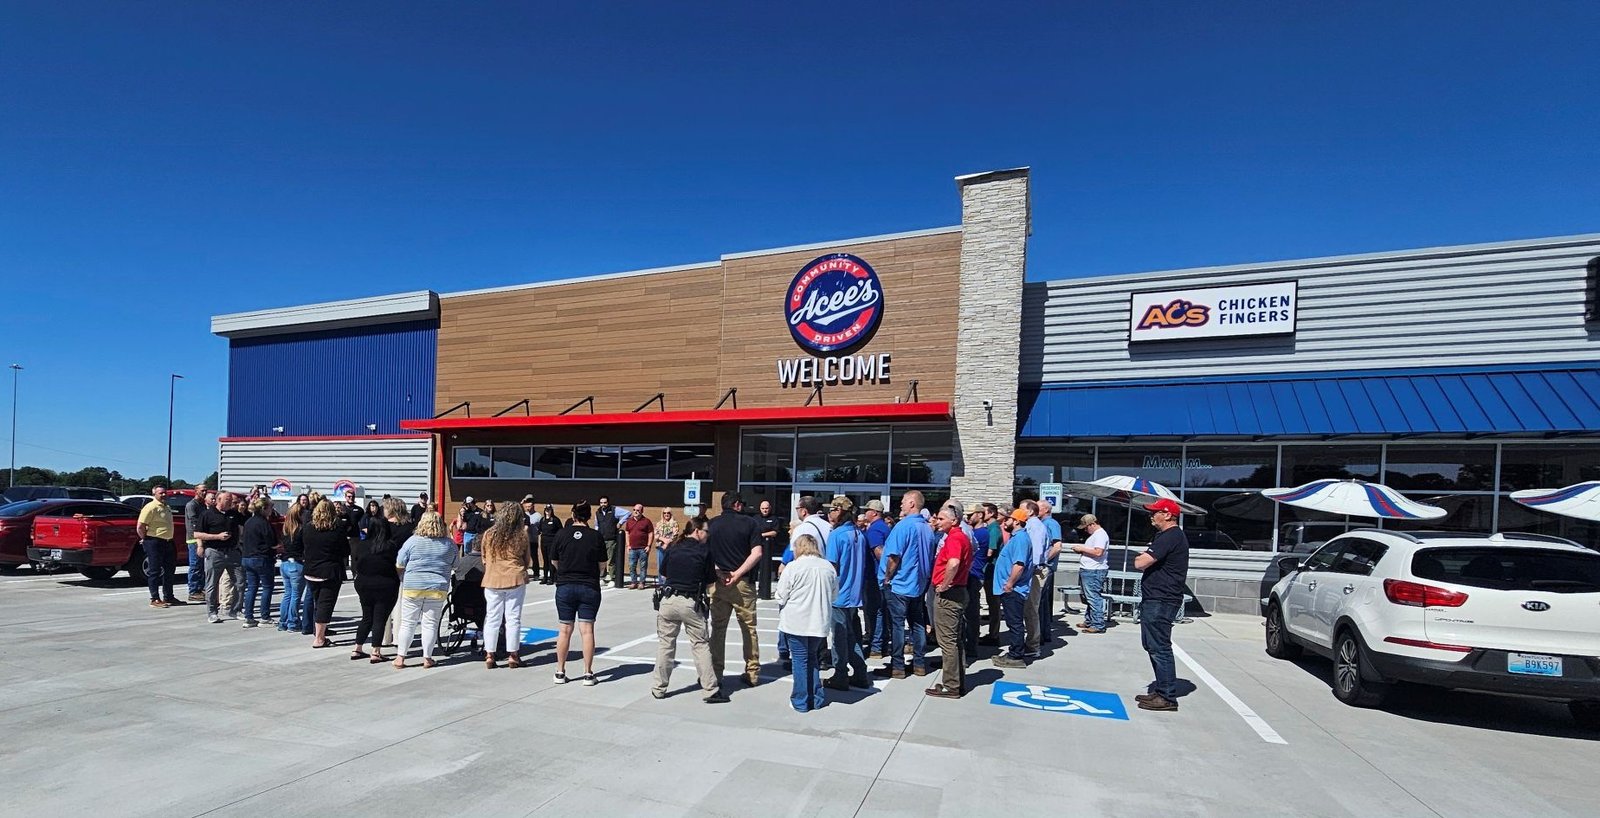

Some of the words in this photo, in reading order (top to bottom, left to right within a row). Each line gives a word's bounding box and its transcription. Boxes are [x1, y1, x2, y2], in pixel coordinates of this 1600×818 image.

[793, 261, 860, 302] COMMUNITY
[790, 278, 879, 326] Acee's
[1218, 295, 1290, 311] CHICKEN
[1219, 310, 1289, 325] FINGERS
[814, 323, 862, 343] DRIVEN
[777, 353, 890, 383] WELCOME
[1525, 602, 1547, 610] KIA
[1525, 660, 1560, 671] B9K597
